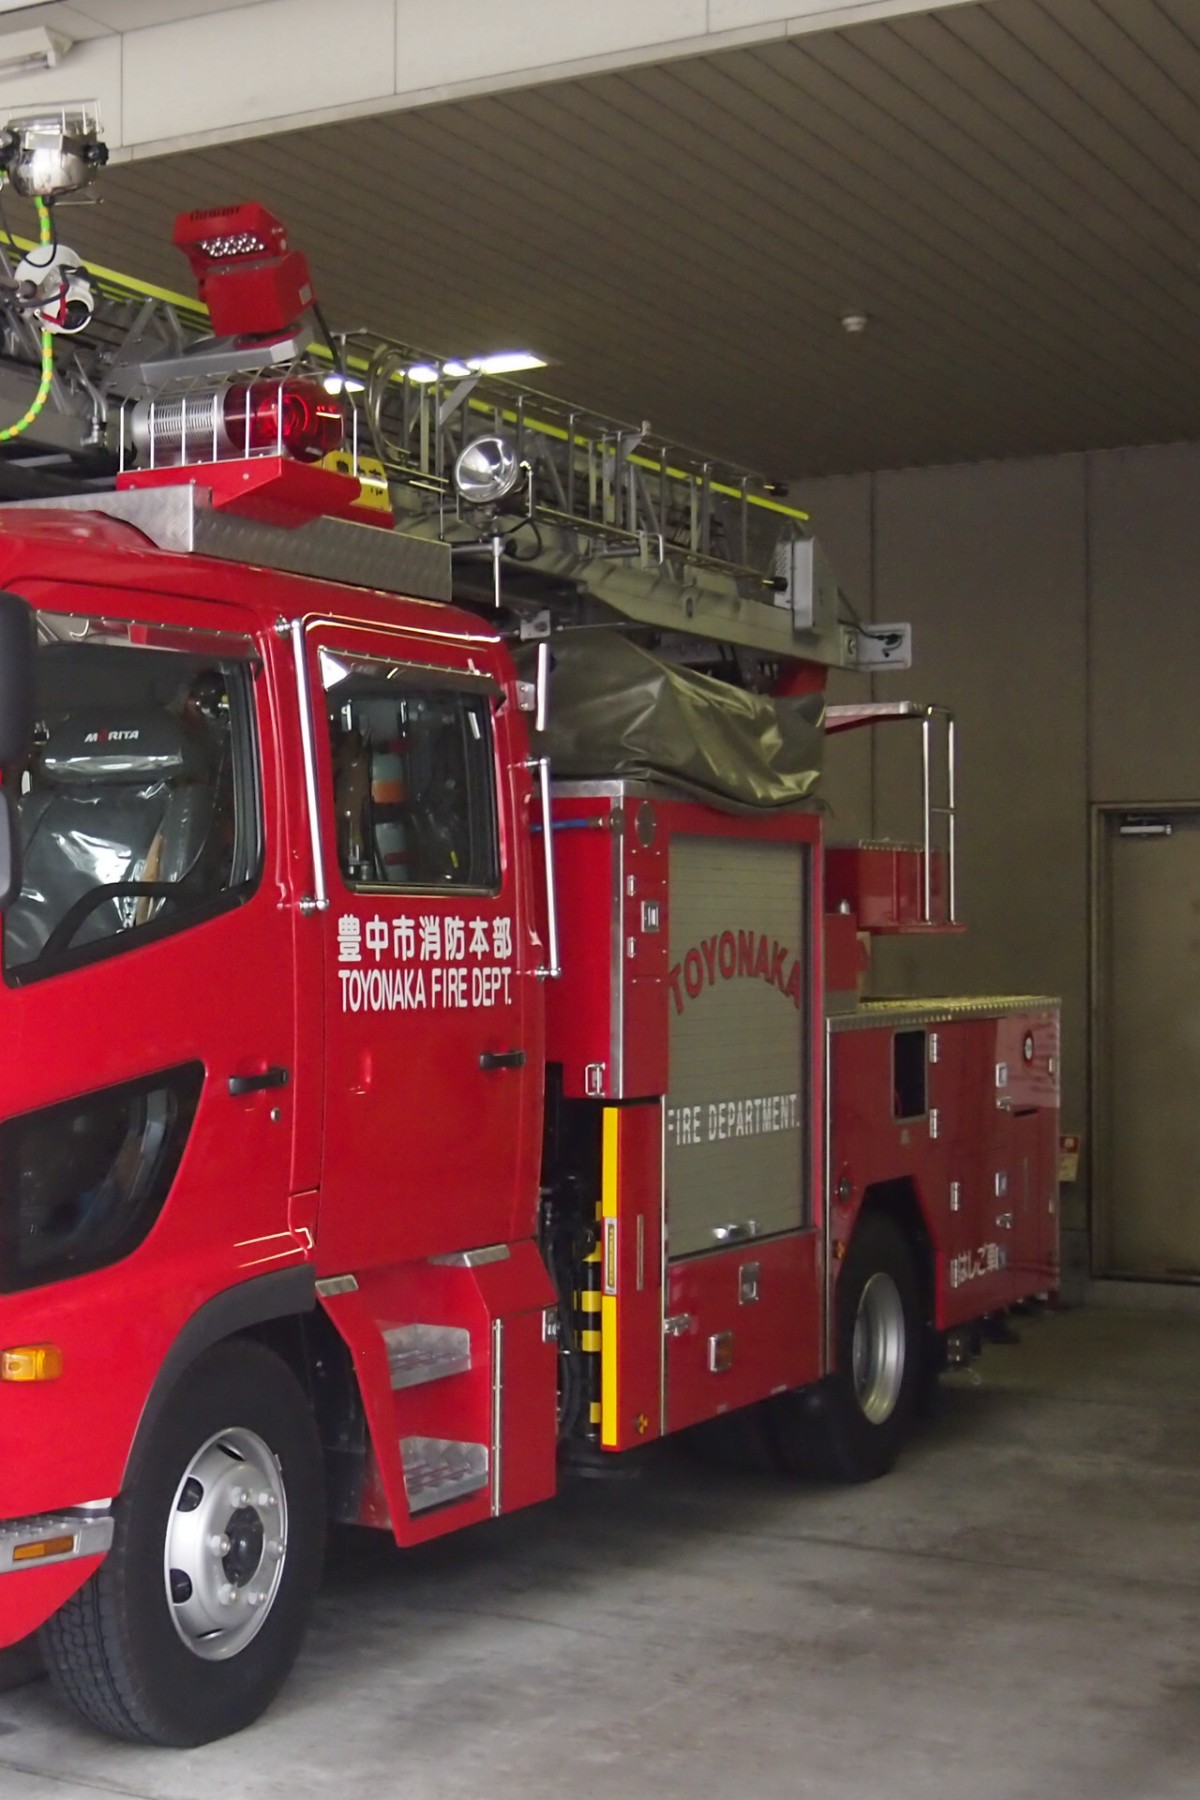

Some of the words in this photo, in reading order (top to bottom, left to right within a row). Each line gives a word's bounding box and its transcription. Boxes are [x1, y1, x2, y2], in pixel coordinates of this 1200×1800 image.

[337, 913, 513, 962] 豊中市消防本部
[338, 968, 427, 1013] TOYONAKA
[431, 967, 469, 1009] FIRE
[472, 966, 513, 1006] DEPT.
[668, 930, 801, 1016] TOYONAKA
